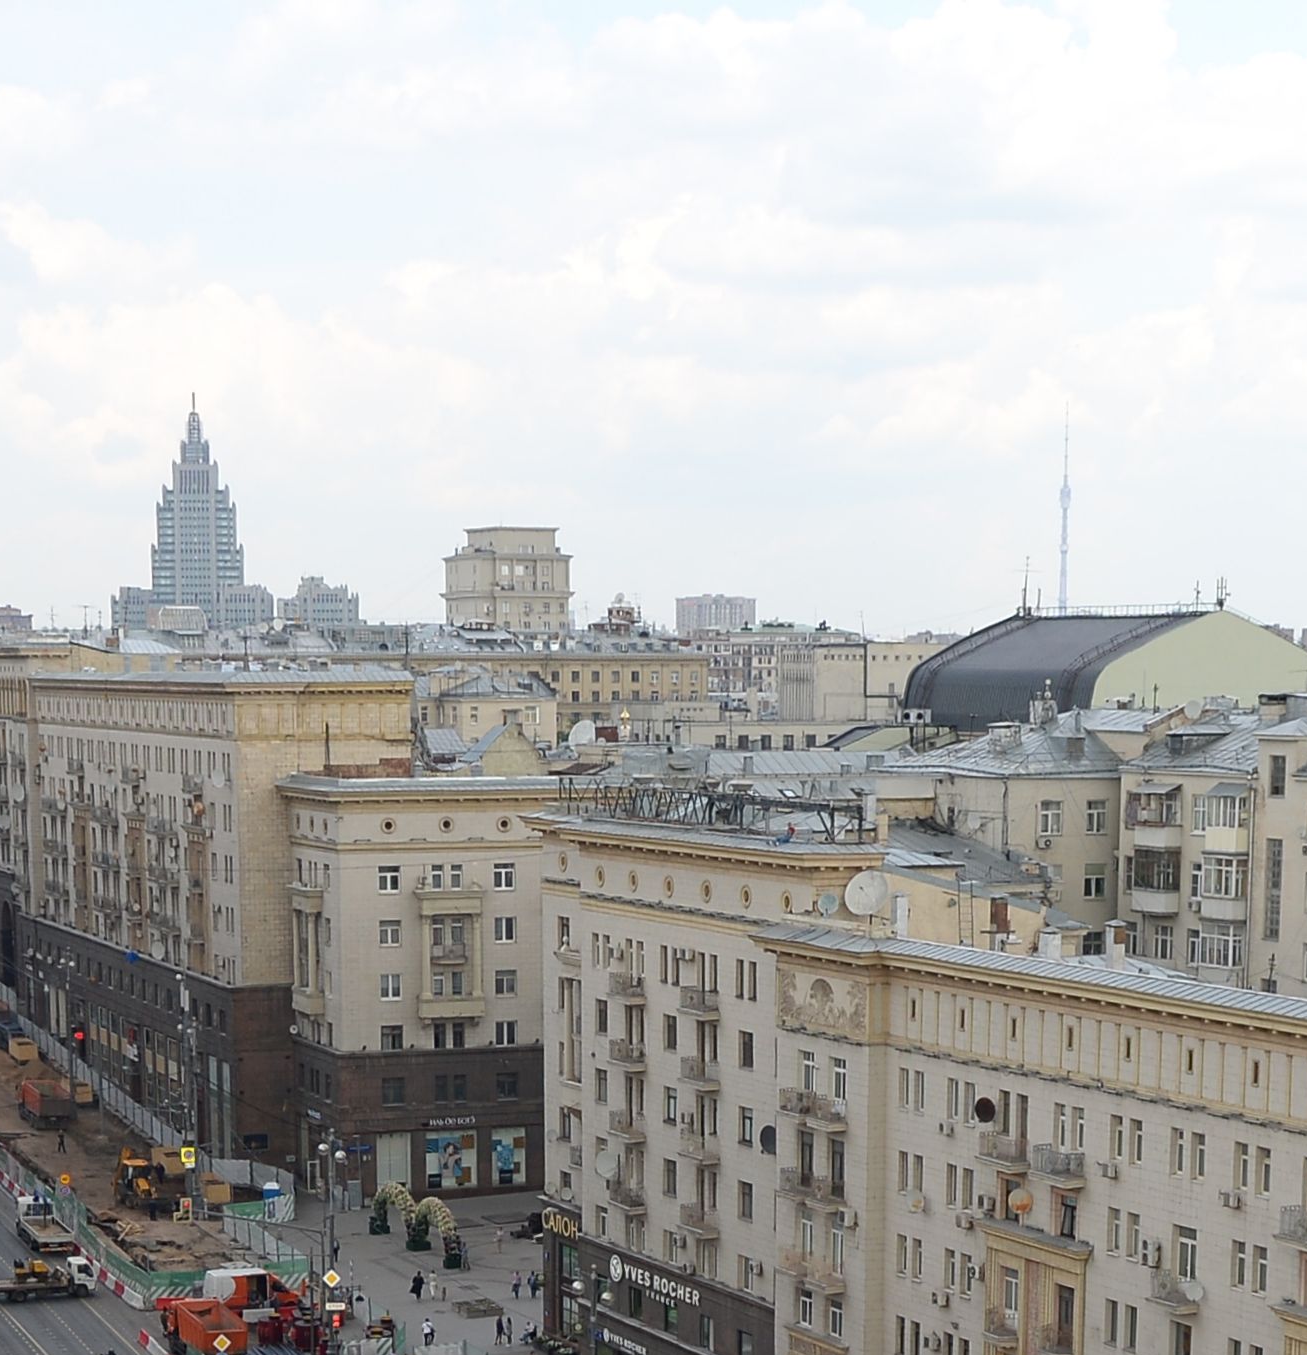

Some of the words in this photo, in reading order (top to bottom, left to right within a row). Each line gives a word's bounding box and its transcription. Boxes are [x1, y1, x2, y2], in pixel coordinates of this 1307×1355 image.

[541, 1207, 578, 1240] САЛОН
[623, 1265, 651, 1287] YVES
[653, 1276, 701, 1307] ROCHER
